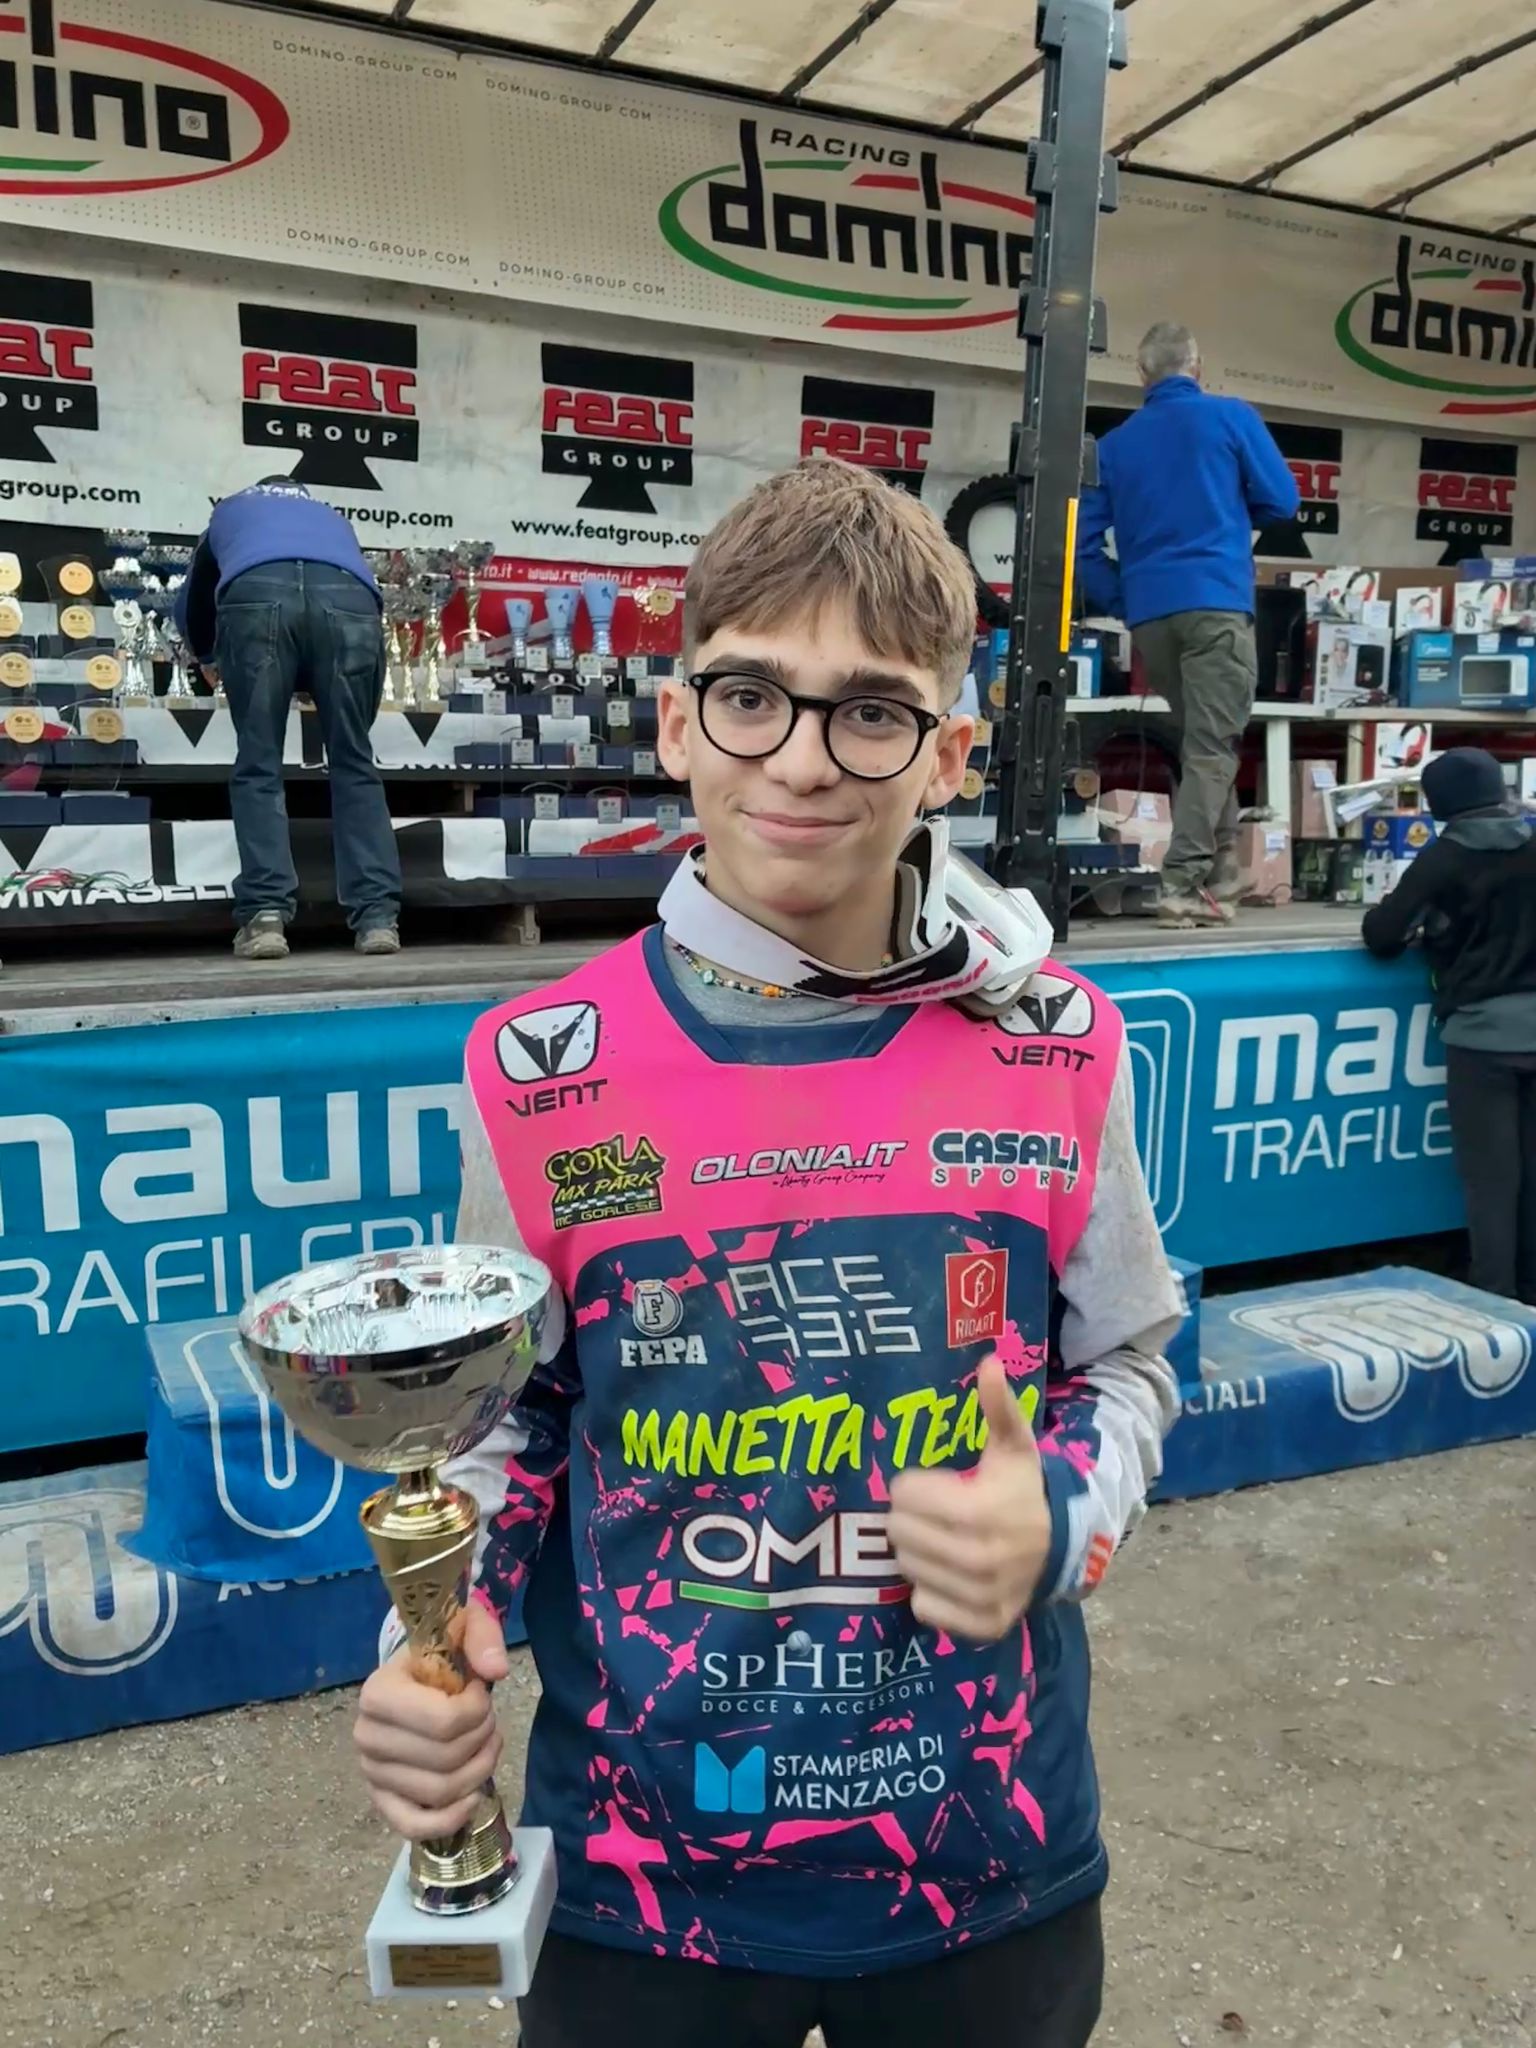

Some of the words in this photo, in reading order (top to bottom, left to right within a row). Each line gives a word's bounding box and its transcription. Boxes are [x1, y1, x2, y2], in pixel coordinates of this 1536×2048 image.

[770, 128, 910, 168] RACING
[1419, 241, 1517, 273] RACING
[1371, 234, 1536, 368] domi
[265, 419, 400, 447] GROUP
[562, 449, 676, 473] GROUP
[511, 517, 706, 549] www.featgroup.co
[1427, 518, 1504, 537] GROUP
[990, 1044, 1096, 1073] VENT
[504, 1078, 609, 1118] VENT
[544, 1134, 665, 1186] GORLA
[930, 1130, 1080, 1173] CASALI
[1211, 1100, 1454, 1184] TRAFILE
[691, 1140, 909, 1185] OLONIA.IT
[933, 1168, 1077, 1192] SPORT
[553, 1181, 591, 1205] MX
[591, 1168, 662, 1195] PARK
[728, 1254, 896, 1312] ACE
[619, 1334, 709, 1368] FEPA
[620, 1391, 866, 1478] MANETTA
[681, 1511, 896, 1584] OME
[701, 1699, 779, 1713] DOCCE
[793, 1700, 805, 1714] &
[819, 1681, 935, 1714] ACCESSORI
[772, 1741, 913, 1778] STAMPERIA
[918, 1734, 944, 1760] DI
[773, 1764, 947, 1811] MENZAGO
